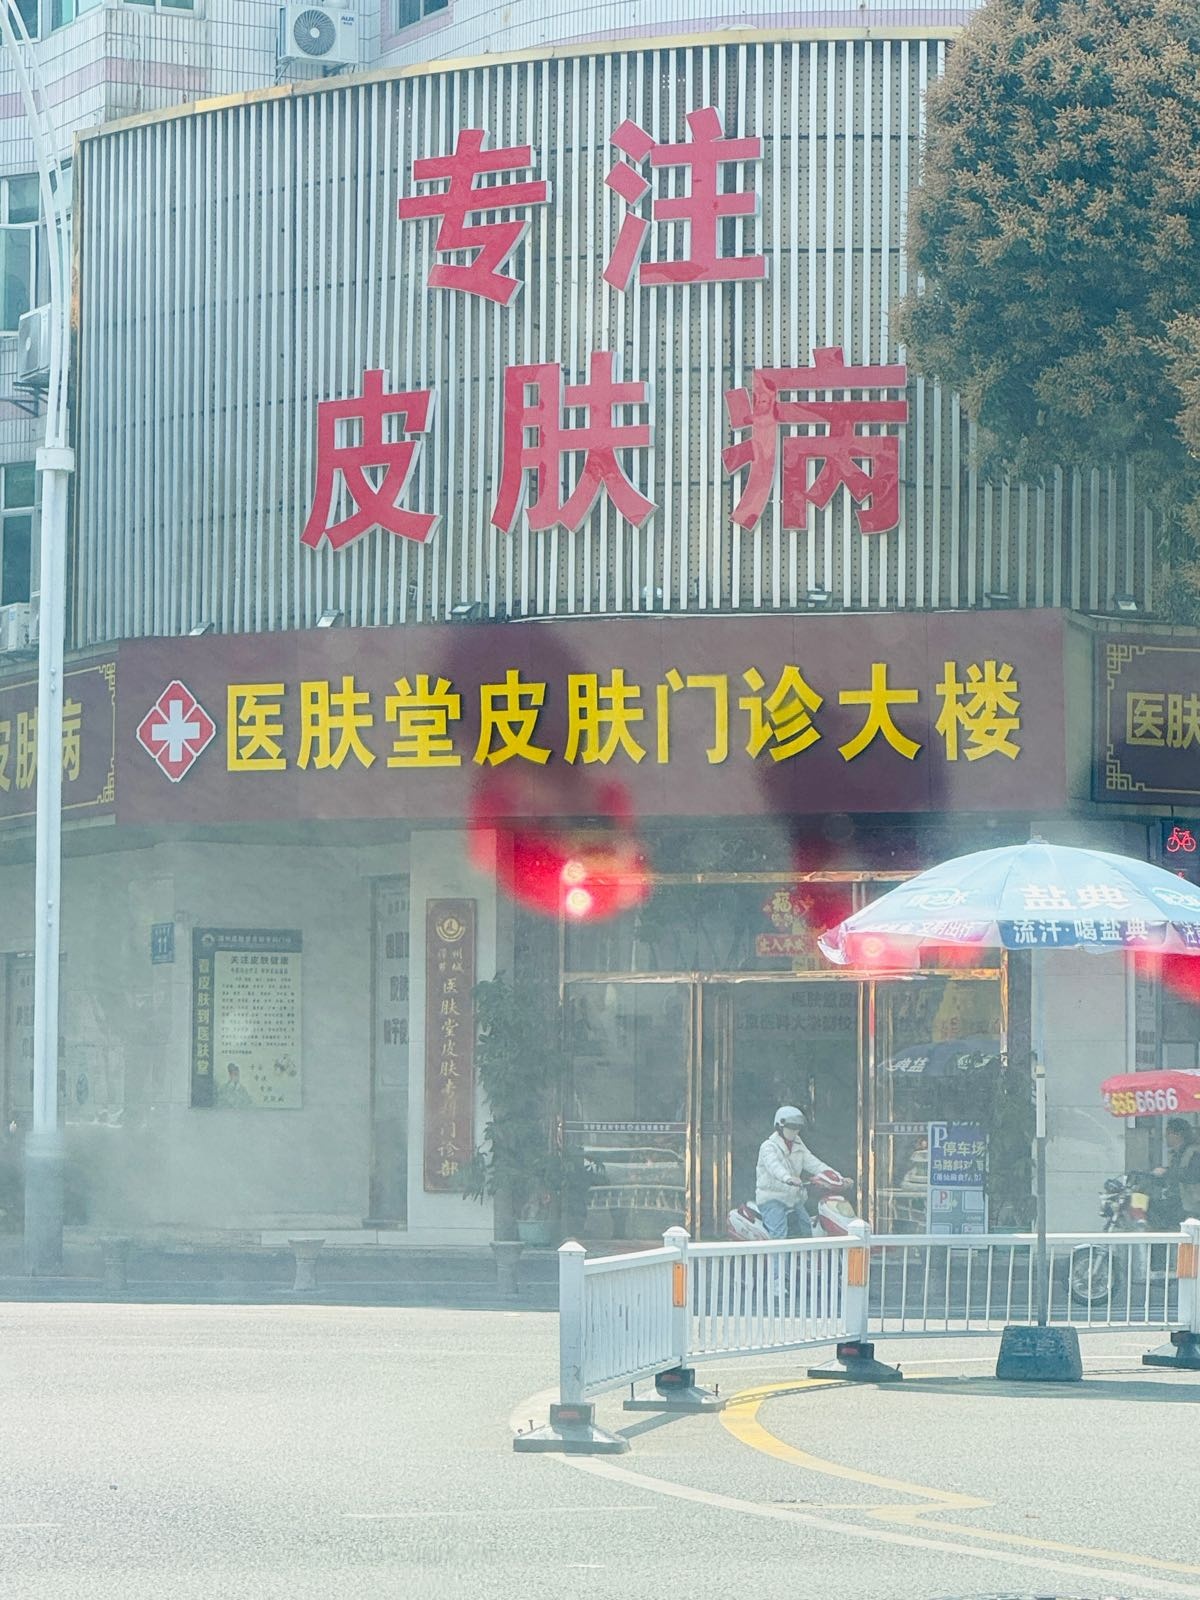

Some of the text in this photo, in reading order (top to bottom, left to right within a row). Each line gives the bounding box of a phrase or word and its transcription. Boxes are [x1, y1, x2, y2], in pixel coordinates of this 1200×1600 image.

[399, 106, 769, 306] 专注
[300, 346, 909, 552] 皮肤病
[226, 660, 1021, 772] 医肤堂皮肤门诊大楼
[1126, 692, 1200, 750] 医肤
[932, 1126, 949, 1149] P
[942, 1140, 986, 1158] 停车场
